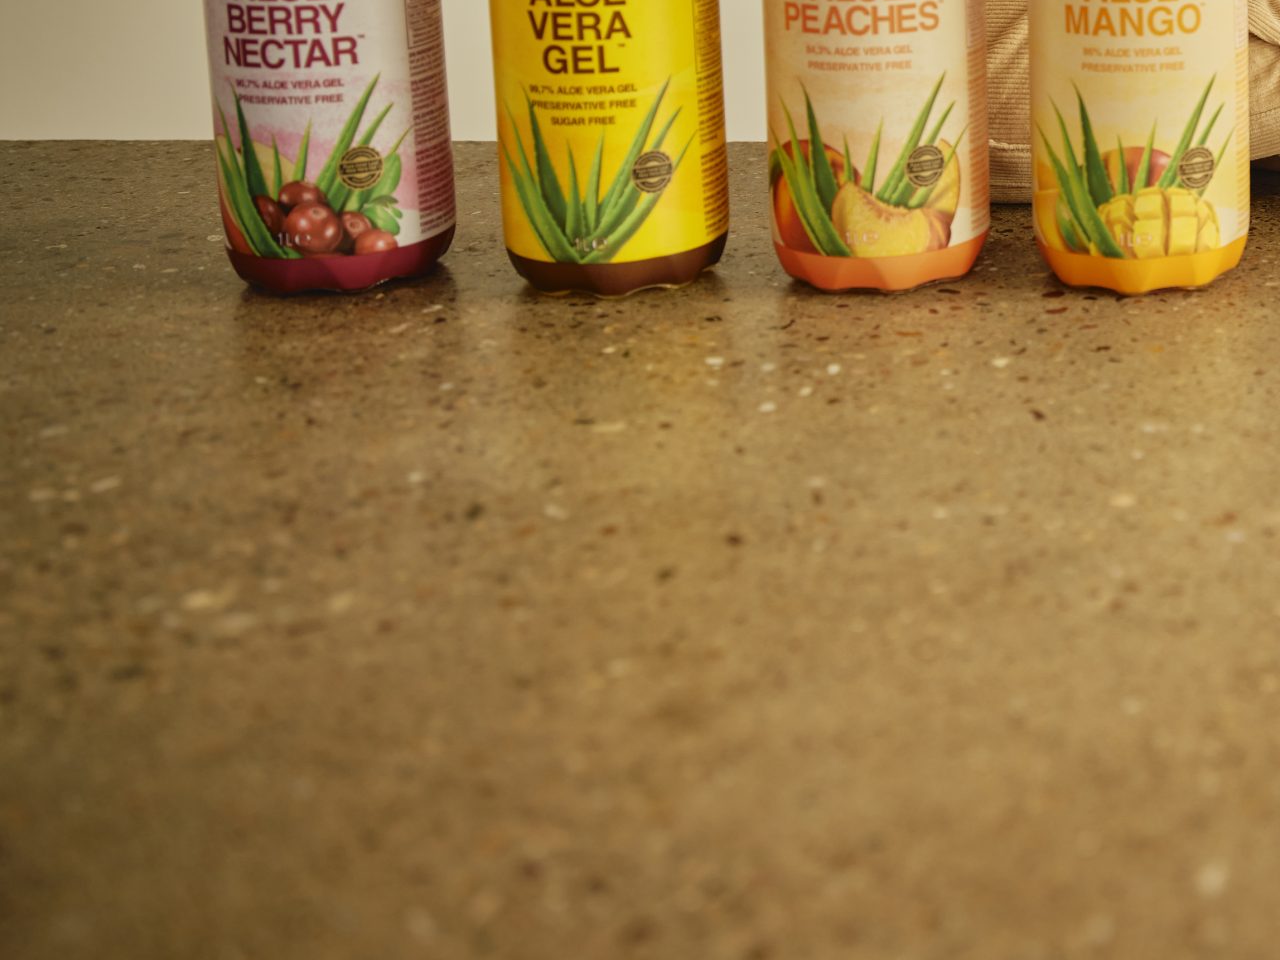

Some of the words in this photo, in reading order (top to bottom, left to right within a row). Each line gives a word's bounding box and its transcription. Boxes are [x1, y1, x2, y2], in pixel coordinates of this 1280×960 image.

[226, 2, 345, 35] BERRY
[527, 10, 632, 41] VERA
[833, 46, 860, 56] ALOE
[862, 46, 891, 56] VERA
[893, 44, 913, 54] GEL
[807, 60, 882, 71] PRESERVATIVE
[884, 60, 913, 70] FREE
[262, 79, 288, 90] ALOE
[290, 79, 321, 90] VERA
[322, 78, 344, 88] GEL
[556, 85, 583, 95] ALOE
[585, 85, 616, 95] VERA
[617, 83, 637, 93] GEL
[238, 94, 312, 105] PRESERVATIVE
[315, 93, 344, 104] FREE
[531, 99, 607, 110] PRESERVATIVE
[609, 98, 637, 109] FREE
[551, 116, 585, 126] SUGAR
[588, 116, 616, 126] FREE
